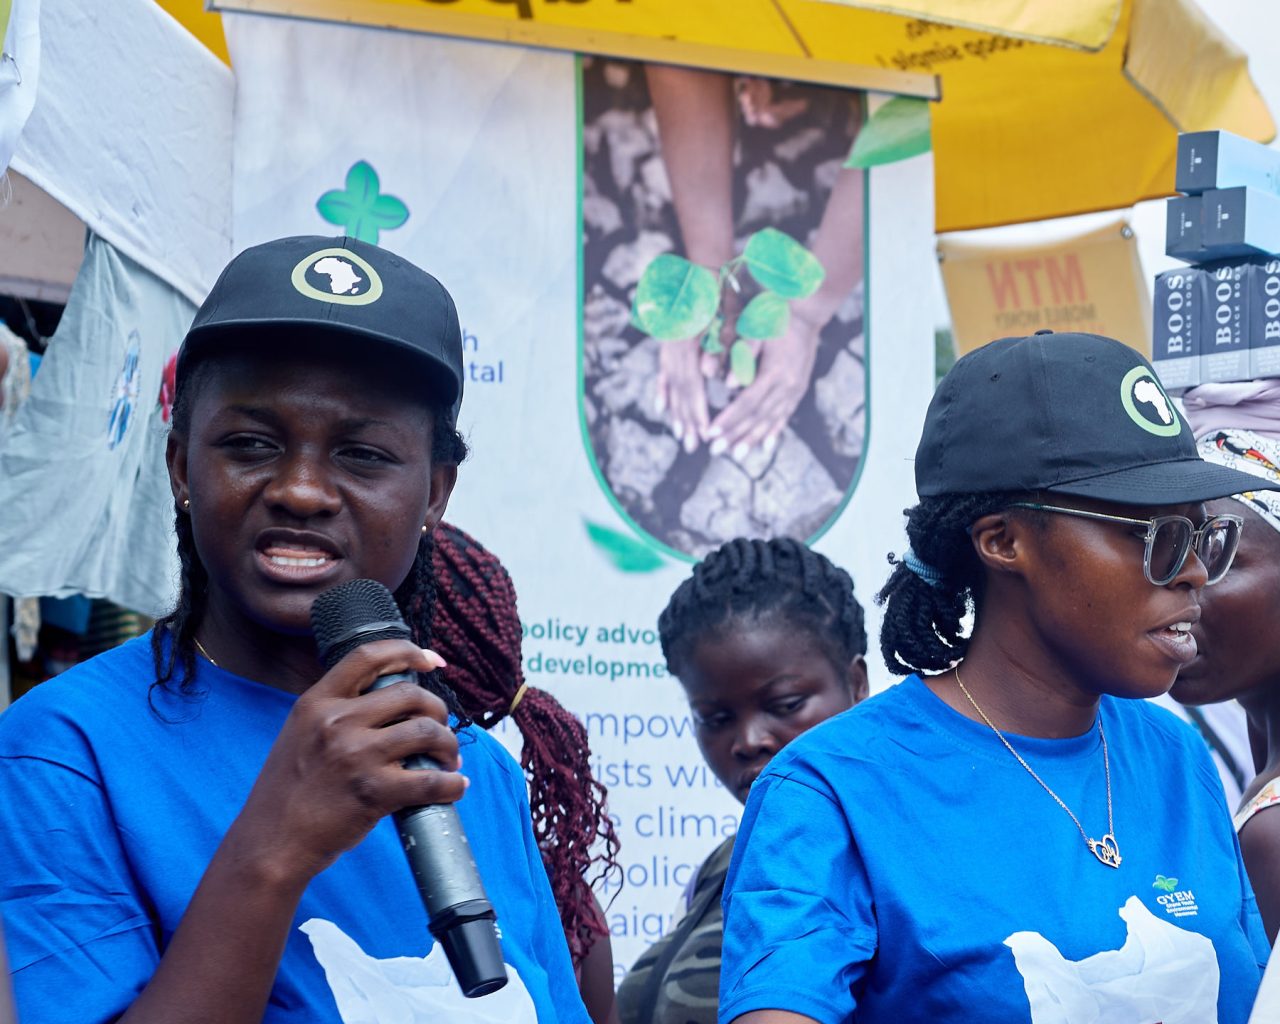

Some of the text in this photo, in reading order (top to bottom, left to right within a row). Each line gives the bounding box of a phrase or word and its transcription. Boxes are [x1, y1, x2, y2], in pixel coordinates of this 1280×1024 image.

[1167, 275, 1184, 354] BOOS
[1215, 266, 1232, 345] BOOS
[1264, 260, 1280, 340] BOOS
[465, 361, 503, 383] tal
[597, 621, 661, 645] advo
[527, 652, 668, 682] developme
[585, 711, 698, 746] mpow
[596, 755, 652, 788] ists
[634, 805, 739, 838] clima
[1156, 890, 1195, 905] GYEM
